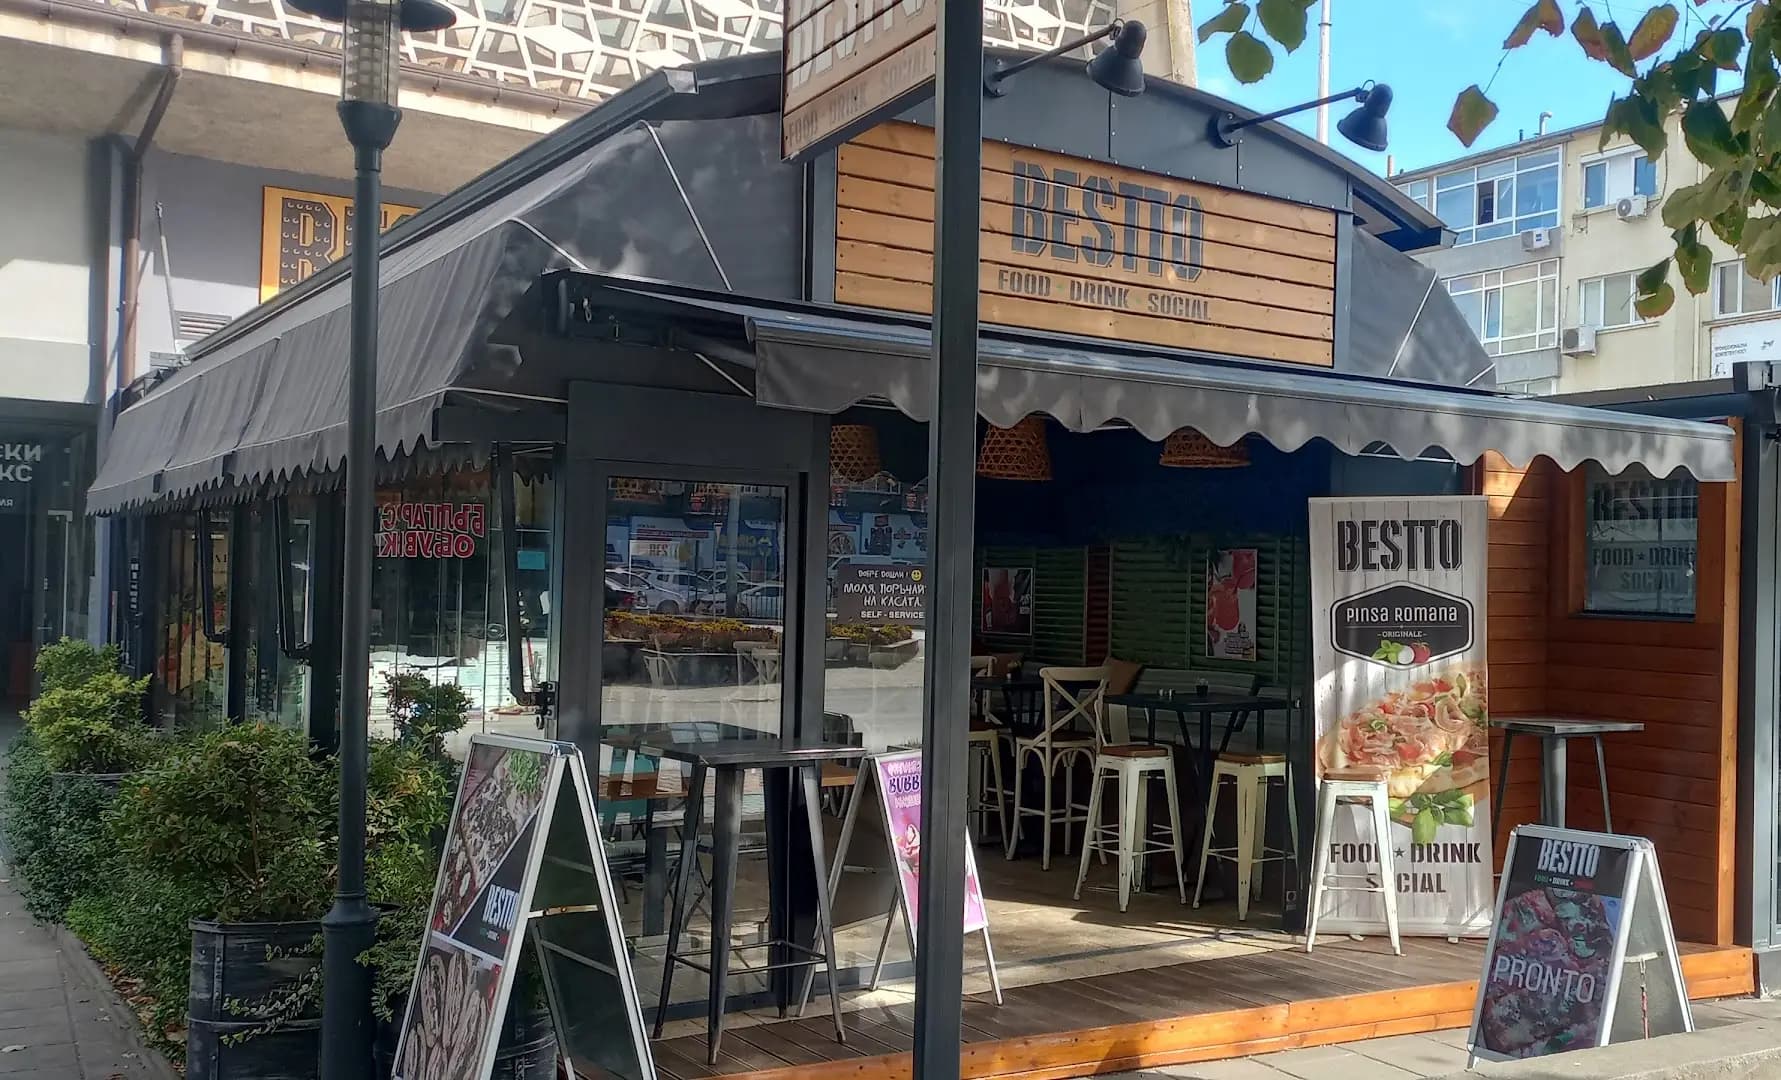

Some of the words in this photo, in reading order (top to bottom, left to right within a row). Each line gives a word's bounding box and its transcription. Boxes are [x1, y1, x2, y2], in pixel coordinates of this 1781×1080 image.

[787, 109, 819, 147] FOOD
[830, 80, 867, 124] DRINK
[1012, 160, 1204, 283] BESTTO
[998, 269, 1051, 297] FOOD
[1070, 279, 1130, 309] DRINK
[1147, 292, 1212, 321] SOCIAL
[1337, 519, 1463, 572] BESTTO
[1593, 547, 1634, 566] FOOD
[880, 583, 926, 595] ПОРЪЧАЙ
[864, 595, 877, 606] НА
[860, 610, 882, 618] SELF
[888, 611, 926, 619] SERVICE
[887, 774, 921, 794] BUBB
[1410, 842, 1482, 864] DRINK
[1537, 838, 1600, 878] BESTTO
[1366, 872, 1447, 893] SCIAL
[1493, 955, 1596, 1004] PRONTO
